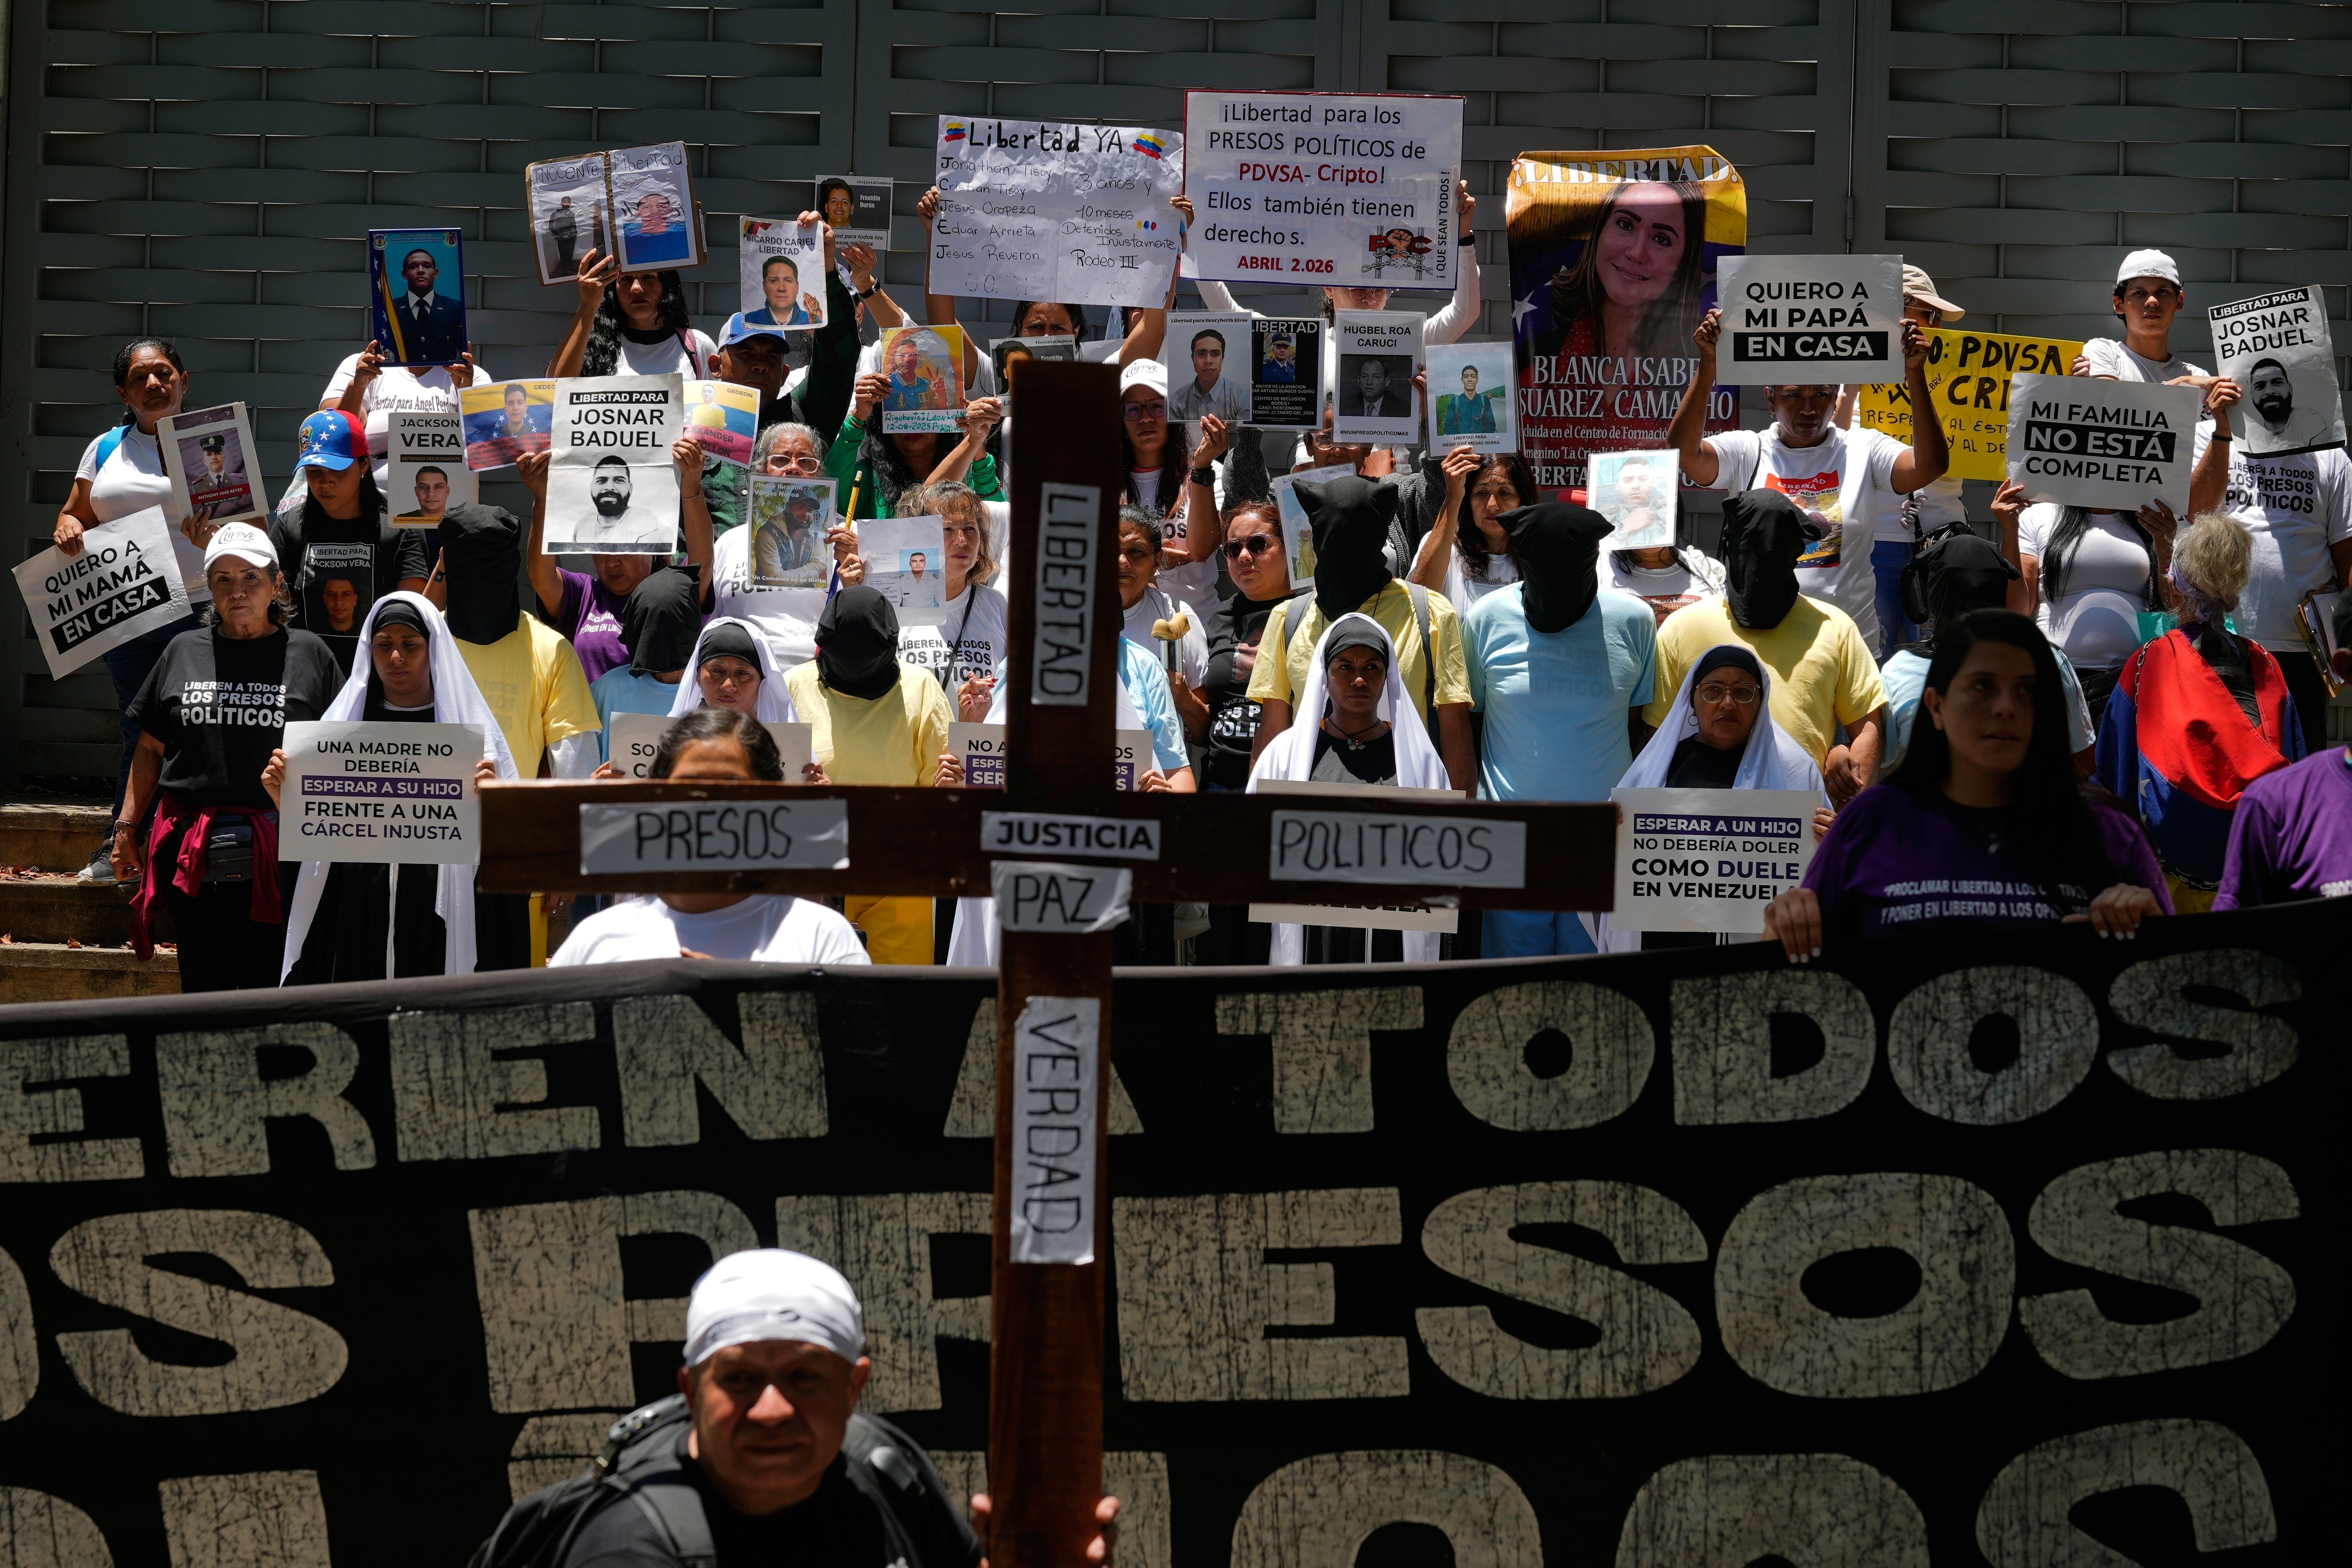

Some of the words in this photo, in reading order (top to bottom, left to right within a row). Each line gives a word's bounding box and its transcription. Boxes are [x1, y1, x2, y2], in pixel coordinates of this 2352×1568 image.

[1224, 103, 1312, 123] ¡Libertad
[1324, 108, 1367, 126] para
[1374, 105, 1401, 124] los
[969, 121, 1080, 153] Libertad
[1094, 128, 1122, 153] YA
[1210, 132, 1284, 150] PRESOS
[1295, 134, 1395, 157] POLÍTICOS
[1401, 141, 1425, 159] de
[940, 157, 1010, 175] Jonathan
[1024, 163, 1052, 185] Tisoy
[939, 178, 990, 193] Cristian
[993, 183, 1026, 203] Tisoy
[940, 200, 975, 214] Jesus
[983, 201, 1036, 215] Oropeza
[1208, 192, 1252, 211] Ellos
[1264, 195, 1344, 216] también
[1352, 198, 1414, 217] tienen
[937, 219, 978, 235] Eduar
[990, 224, 1035, 237] Arrieta
[744, 234, 783, 245] RICARDO
[785, 237, 815, 246] CARIEL
[759, 245, 799, 255] LIBERTAD
[936, 245, 974, 259] Jesus
[1238, 255, 1283, 271] ABRIL
[1291, 258, 1333, 273] 2.026
[1746, 282, 1844, 303] QUIERO
[1851, 282, 1869, 299] A
[1746, 308, 1777, 328] MI
[1788, 302, 1869, 328] PAPÁ
[2213, 298, 2270, 319] LIBERTAD
[2272, 291, 2305, 306] PARA
[2218, 307, 2310, 340] JOSNAR
[1748, 337, 1785, 357] EN
[1795, 336, 1874, 356] CASA
[2221, 328, 2313, 360] BADUEL
[1534, 356, 1628, 385] BLANCA
[573, 393, 629, 403] LIBERTAD
[632, 392, 665, 402] PARA
[727, 388, 753, 398] GEDEON
[1520, 388, 1605, 418] SUAREZ
[400, 419, 459, 427] JACKSON
[572, 409, 664, 426] JOSNAR
[2031, 401, 2059, 419] MI
[2068, 404, 2169, 429] FAMILIA
[400, 433, 461, 447] VERA
[571, 431, 663, 448] BADUEL
[2030, 427, 2077, 451] NO
[2087, 431, 2165, 459] ESTÁ
[2026, 456, 2163, 485] COMPLETA
[2279, 467, 2315, 481] TODOS
[2257, 477, 2314, 495] PRESOS
[2226, 488, 2314, 513] POLÍTICOS
[45, 547, 117, 594] QUIERO
[125, 540, 141, 557] A
[308, 560, 349, 568] JACKSON
[46, 597, 72, 622] MI
[75, 556, 153, 609] MAMÁ
[1040, 493, 1089, 696] LIBERTAD
[62, 617, 90, 644] EN
[94, 584, 161, 630] CASA
[184, 681, 232, 691] LIBEREN
[235, 683, 244, 691] A
[248, 683, 286, 694] TODOS
[182, 691, 213, 705] LOS
[218, 693, 286, 707] PRESOS
[181, 704, 285, 728] POLÍTICOS
[317, 741, 354, 753] UNA
[360, 742, 421, 756] MADRE
[427, 744, 453, 756] NO
[345, 758, 420, 774] DEBERÍA
[304, 780, 377, 794] ESPERAR
[382, 782, 394, 794] A
[397, 782, 418, 794] SU
[423, 783, 460, 796] HIJO
[304, 802, 384, 818] FRENTE
[391, 804, 406, 818] A
[413, 805, 457, 820] UNA
[301, 819, 377, 838] CÁRCEL
[384, 825, 462, 840] INJUSTA
[635, 806, 792, 861] PRESOS
[997, 820, 1154, 851] JUSTICIA
[1636, 818, 1711, 831] ESPERAR
[1715, 820, 1728, 832] A
[1732, 820, 1756, 833] UN
[1761, 821, 1799, 834] HIJO
[1280, 819, 1492, 872] POLITICOS
[1634, 838, 1658, 850] NO
[1663, 837, 1737, 852] DEBERÍA
[1743, 841, 1799, 854] DOLER
[1632, 858, 1709, 877] COMO
[1718, 861, 1800, 879] DUELE
[1013, 874, 1095, 924] PAZ
[1215, 947, 2302, 1134] TODOS
[1023, 1014, 1081, 1235] VERDAD
